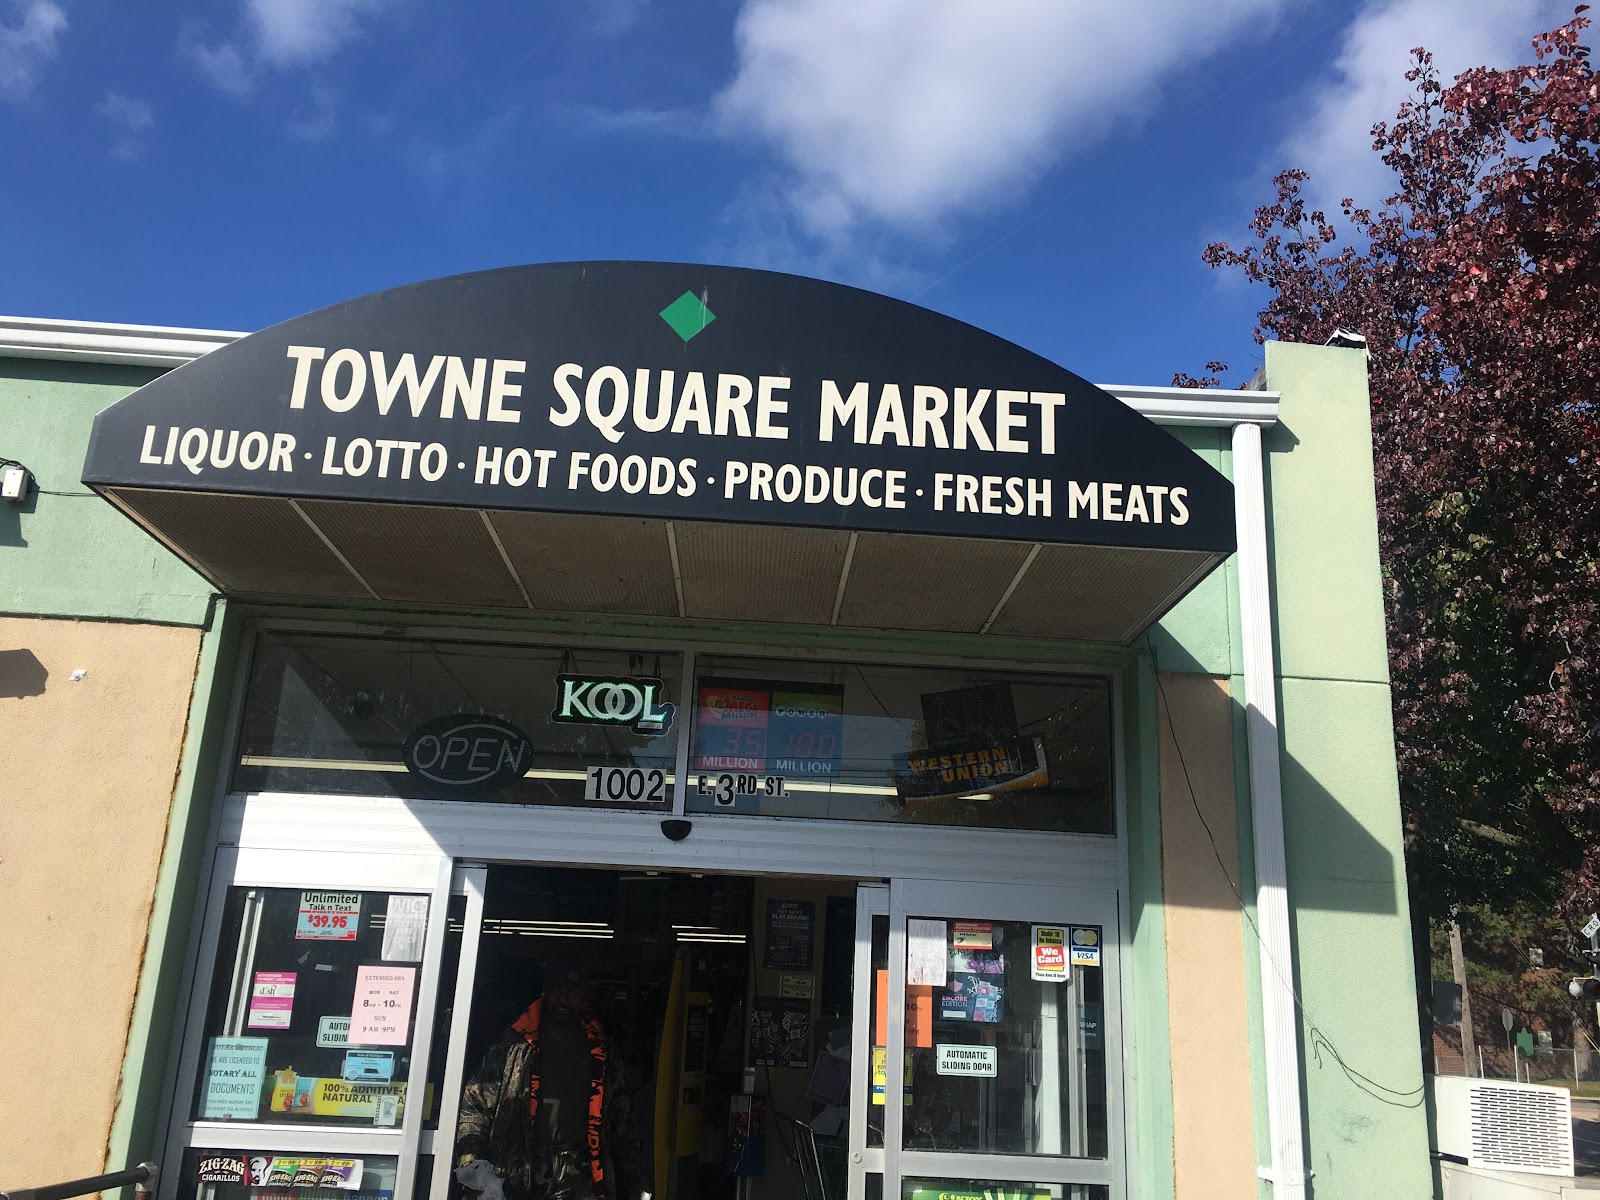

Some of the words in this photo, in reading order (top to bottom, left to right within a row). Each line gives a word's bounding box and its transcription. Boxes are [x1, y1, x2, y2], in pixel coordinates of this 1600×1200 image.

[286, 345, 526, 424] TOWNE
[549, 363, 791, 443] SQUARE
[818, 379, 1066, 455] MARKET
[139, 425, 298, 476] LIQUOR
[322, 436, 448, 482] LOTTO
[474, 446, 557, 489] HOT
[568, 451, 697, 497] FOODS
[724, 461, 907, 509] PRODUCE
[934, 472, 1053, 518] FRESH
[1068, 480, 1190, 526] MEATS
[559, 680, 667, 722] KOOL
[720, 712, 758, 720] MILLIONS
[413, 732, 526, 773] OPEN
[702, 756, 758, 769] MILLION
[908, 747, 1006, 773] WESTERN
[776, 760, 832, 773] MILLION
[942, 760, 1010, 782] UNION
[591, 768, 663, 801] 1002
[698, 775, 713, 795] E.
[716, 774, 757, 805] 3RD
[765, 777, 789, 797] ST.
[304, 893, 359, 904] Unlimited
[308, 914, 348, 928] $39.95
[1037, 955, 1063, 963] Card
[322, 1033, 349, 1042] SLIDIN
[218, 1056, 228, 1064] ARE
[946, 1050, 988, 1060] AUTOMATIC
[942, 1061, 971, 1070] SLIDING
[972, 1062, 992, 1071] DOOR
[208, 1069, 240, 1078] NOTARY
[210, 1083, 255, 1094] DOCUMENTS
[324, 1083, 349, 1092] 100%
[322, 1093, 372, 1103] NATURAL
[198, 1158, 245, 1175] ZIG-ZAG
[202, 1174, 240, 1182] CIGARILLOS
